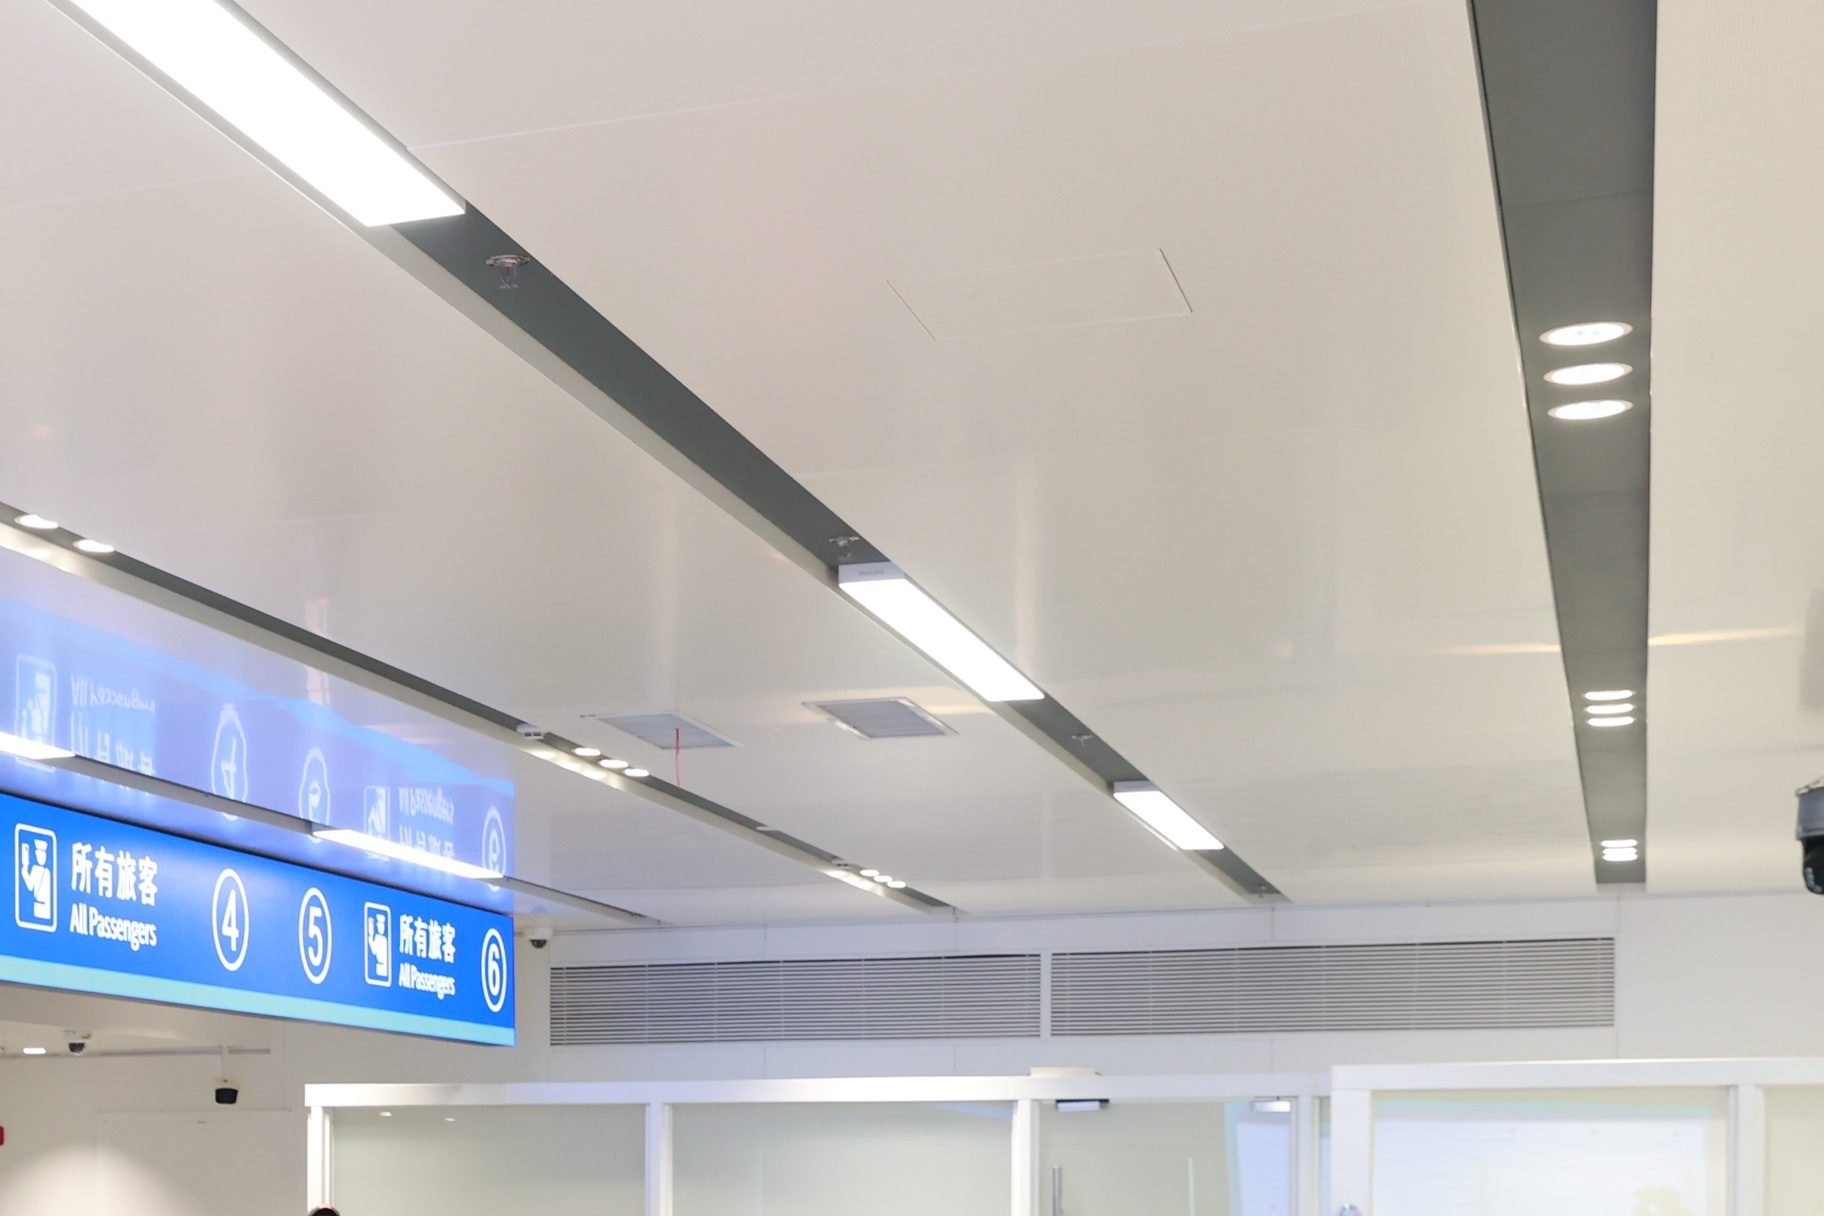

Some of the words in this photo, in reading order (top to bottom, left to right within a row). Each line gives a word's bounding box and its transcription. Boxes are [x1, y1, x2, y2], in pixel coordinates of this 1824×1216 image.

[71, 841, 158, 907] 所有旅客
[69, 902, 88, 936] All
[88, 905, 158, 952] Passengers
[220, 888, 240, 954] 4
[307, 913, 324, 969] 5
[399, 913, 456, 964] 所有旅客
[398, 962, 411, 989] All
[410, 964, 456, 1001] Passengers
[487, 942, 502, 997] 6
